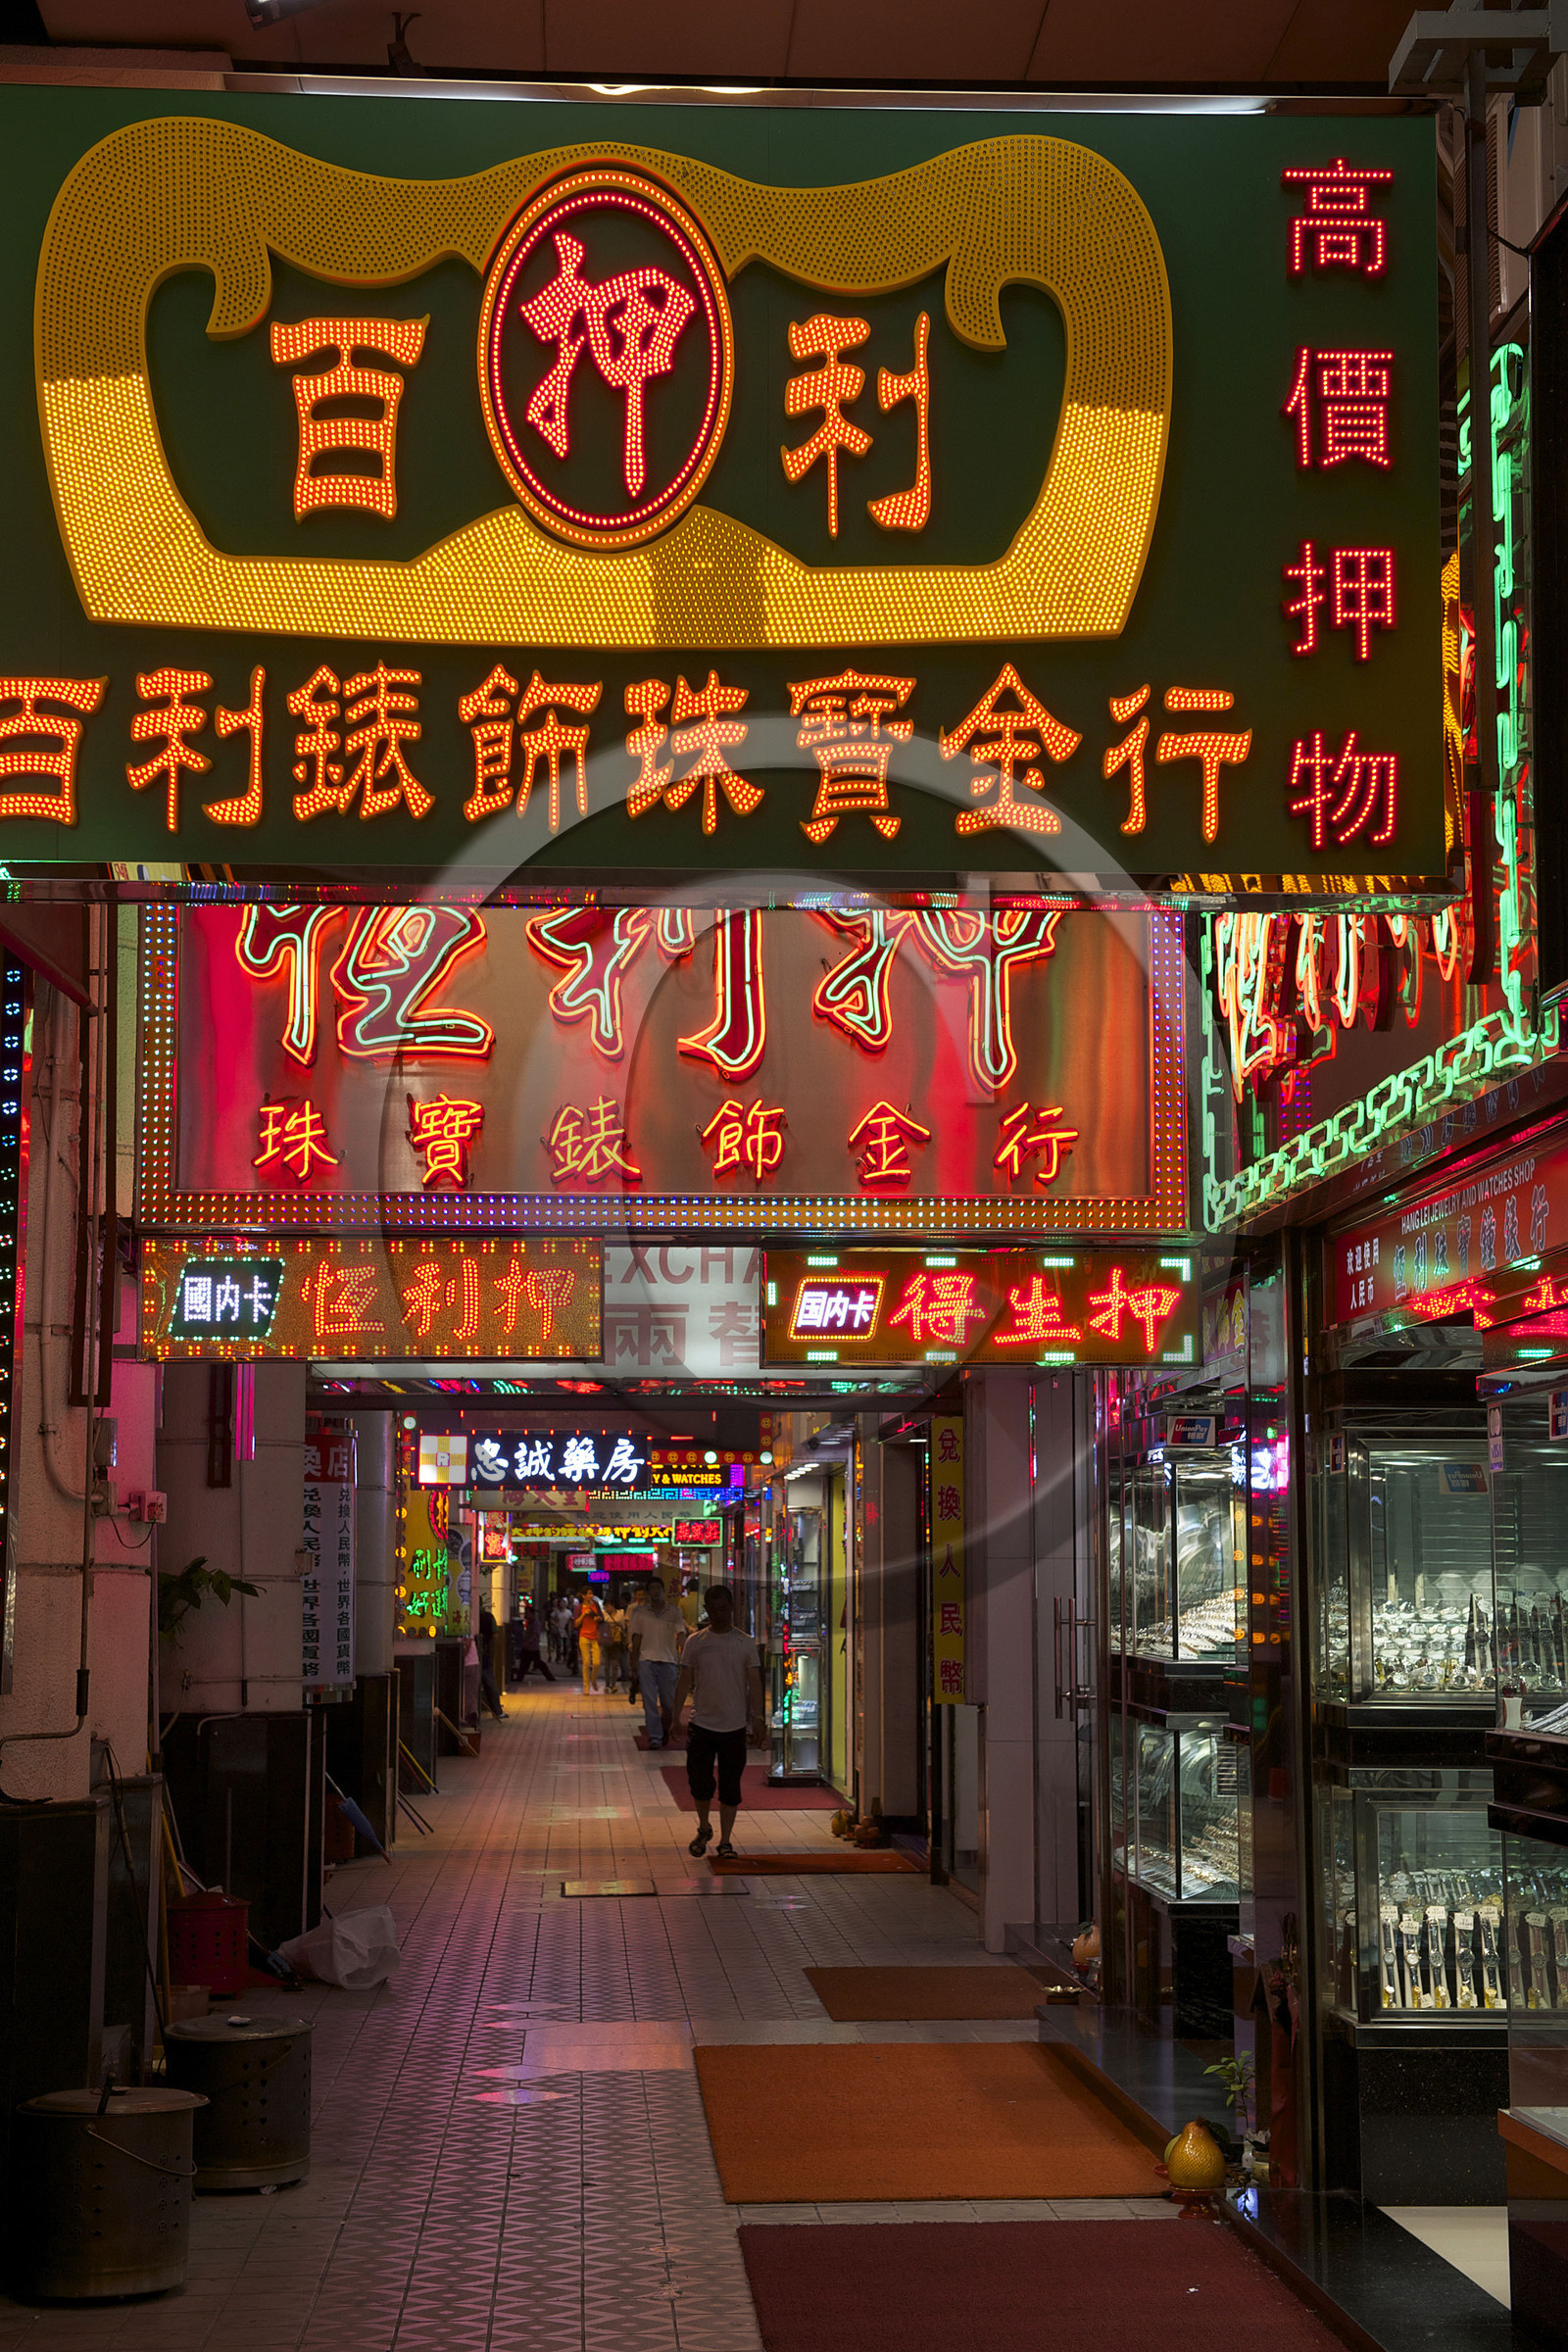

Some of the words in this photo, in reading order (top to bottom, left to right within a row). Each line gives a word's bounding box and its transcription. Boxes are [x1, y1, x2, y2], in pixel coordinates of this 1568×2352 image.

[1281, 157, 1398, 851] 高價押物
[0, 659, 1253, 845] 百利錶飾珠寶金行
[252, 1093, 1079, 1186] 珠寶錶飾金行
[1401, 1209, 1420, 1235] HANG
[1420, 1206, 1431, 1228] LEI
[1430, 1194, 1461, 1223] JEWELRY
[1461, 1187, 1477, 1210] AND
[1477, 1169, 1513, 1201] WATCHES
[1512, 1157, 1536, 1187] SHOP
[796, 1289, 875, 1329] 国内卡
[889, 1267, 1183, 1354] 得生押
[470, 1437, 646, 1484] 忠誠藥房
[1174, 1424, 1208, 1435] UnionPay
[671, 1473, 723, 1485] WATCHES
